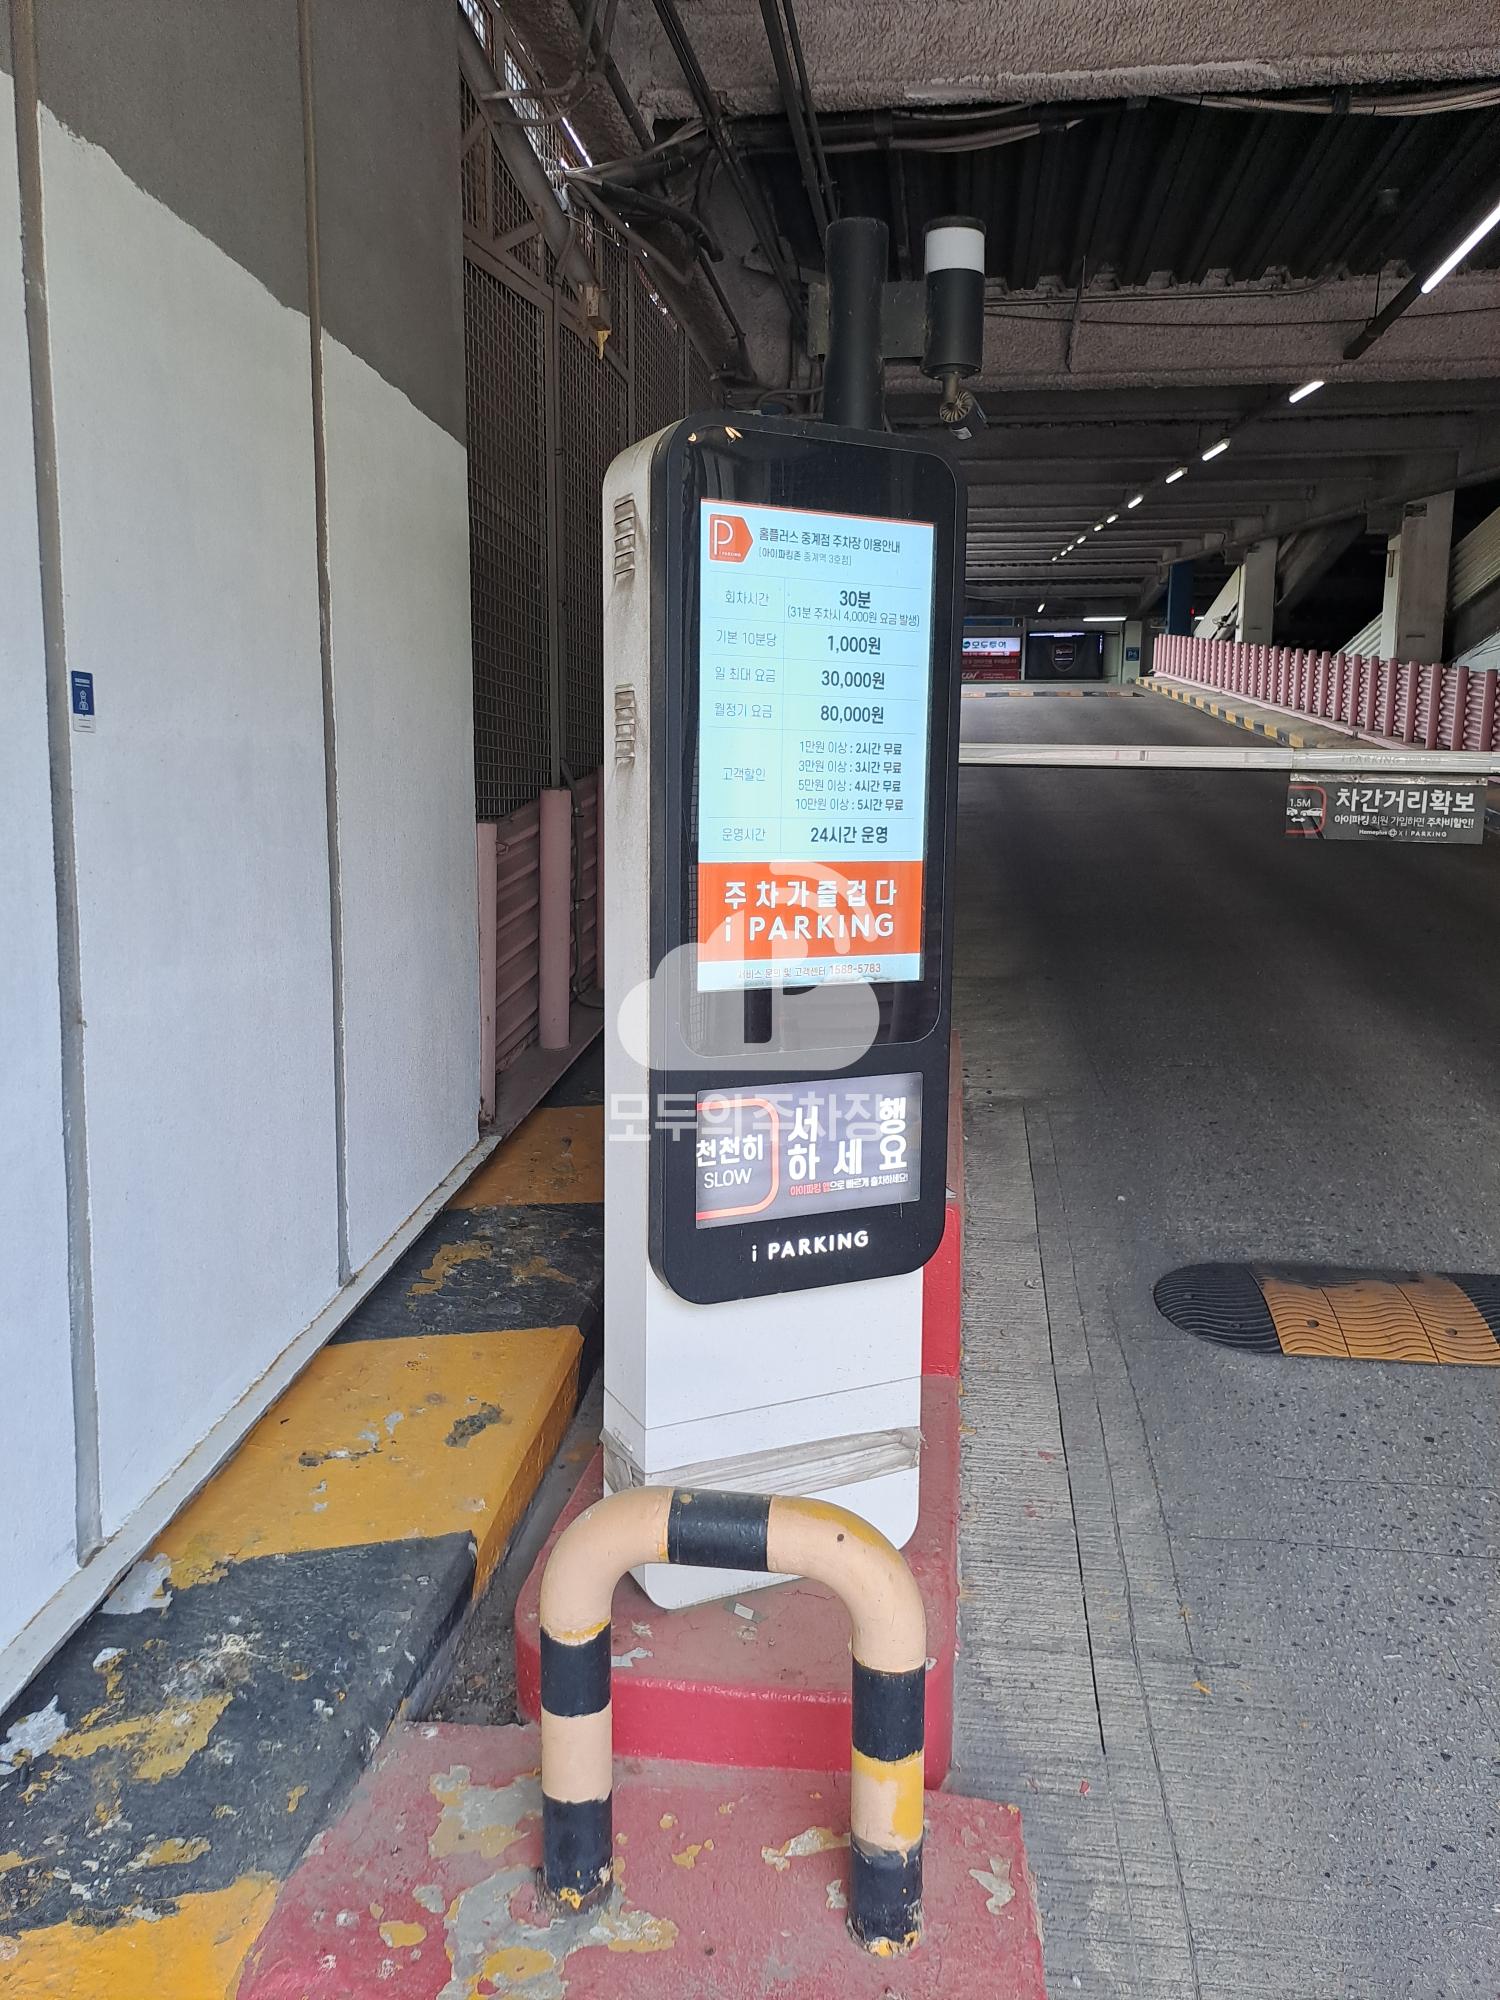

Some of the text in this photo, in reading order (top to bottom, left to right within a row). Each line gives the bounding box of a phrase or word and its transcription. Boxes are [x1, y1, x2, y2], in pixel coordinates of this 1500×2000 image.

[760, 528, 900, 553] 홈플러스 중계점 주차장 이용안내
[725, 590, 769, 607] 회차시간
[840, 590, 870, 609] 30분
[788, 606, 920, 627] (31분 주차시 4,000원 요금 발생)
[716, 630, 776, 647] 기본 10분당
[828, 636, 880, 655] 1,000원
[715, 666, 776, 682] 일 최대 요금
[822, 670, 884, 690] 30,000원
[714, 703, 772, 718] 월정기 요금
[820, 705, 884, 724] 80,000원
[800, 740, 825, 754] 1만원
[828, 741, 847, 754] 이상
[856, 742, 880, 755] 2시간
[884, 743, 902, 756] 무료
[722, 767, 766, 782] 고객할인
[798, 760, 824, 773] 3만원
[828, 760, 847, 773] 이상
[856, 761, 880, 774] 3시간
[884, 762, 902, 774] 무료
[798, 780, 824, 792] 5만원
[828, 780, 846, 792] 이상
[854, 780, 880, 793] 4시간
[882, 780, 901, 792] 무료
[796, 798, 826, 810] 10만원
[830, 798, 848, 810] 이상
[857, 799, 882, 811] 5시간
[885, 799, 903, 811] 무료
[1290, 798, 1311, 808] 1.5M
[1336, 788, 1476, 816] 차간거리확보
[1334, 814, 1474, 828] 아이파킹 회원 가입하면 주차비할인!
[722, 828, 766, 842] 운영시간
[810, 826, 888, 844] 24시간 운영
[1410, 830, 1447, 838] PARKING
[725, 913, 894, 942] i PARKING
[795, 966, 826, 977] 고객센터
[696, 1133, 764, 1168] 천천히
[704, 1168, 752, 1189] SLOW
[790, 1184, 820, 1196] 아이파킹
[846, 1177, 869, 1189] 빠르게
[752, 1230, 869, 1262] i PARKING
